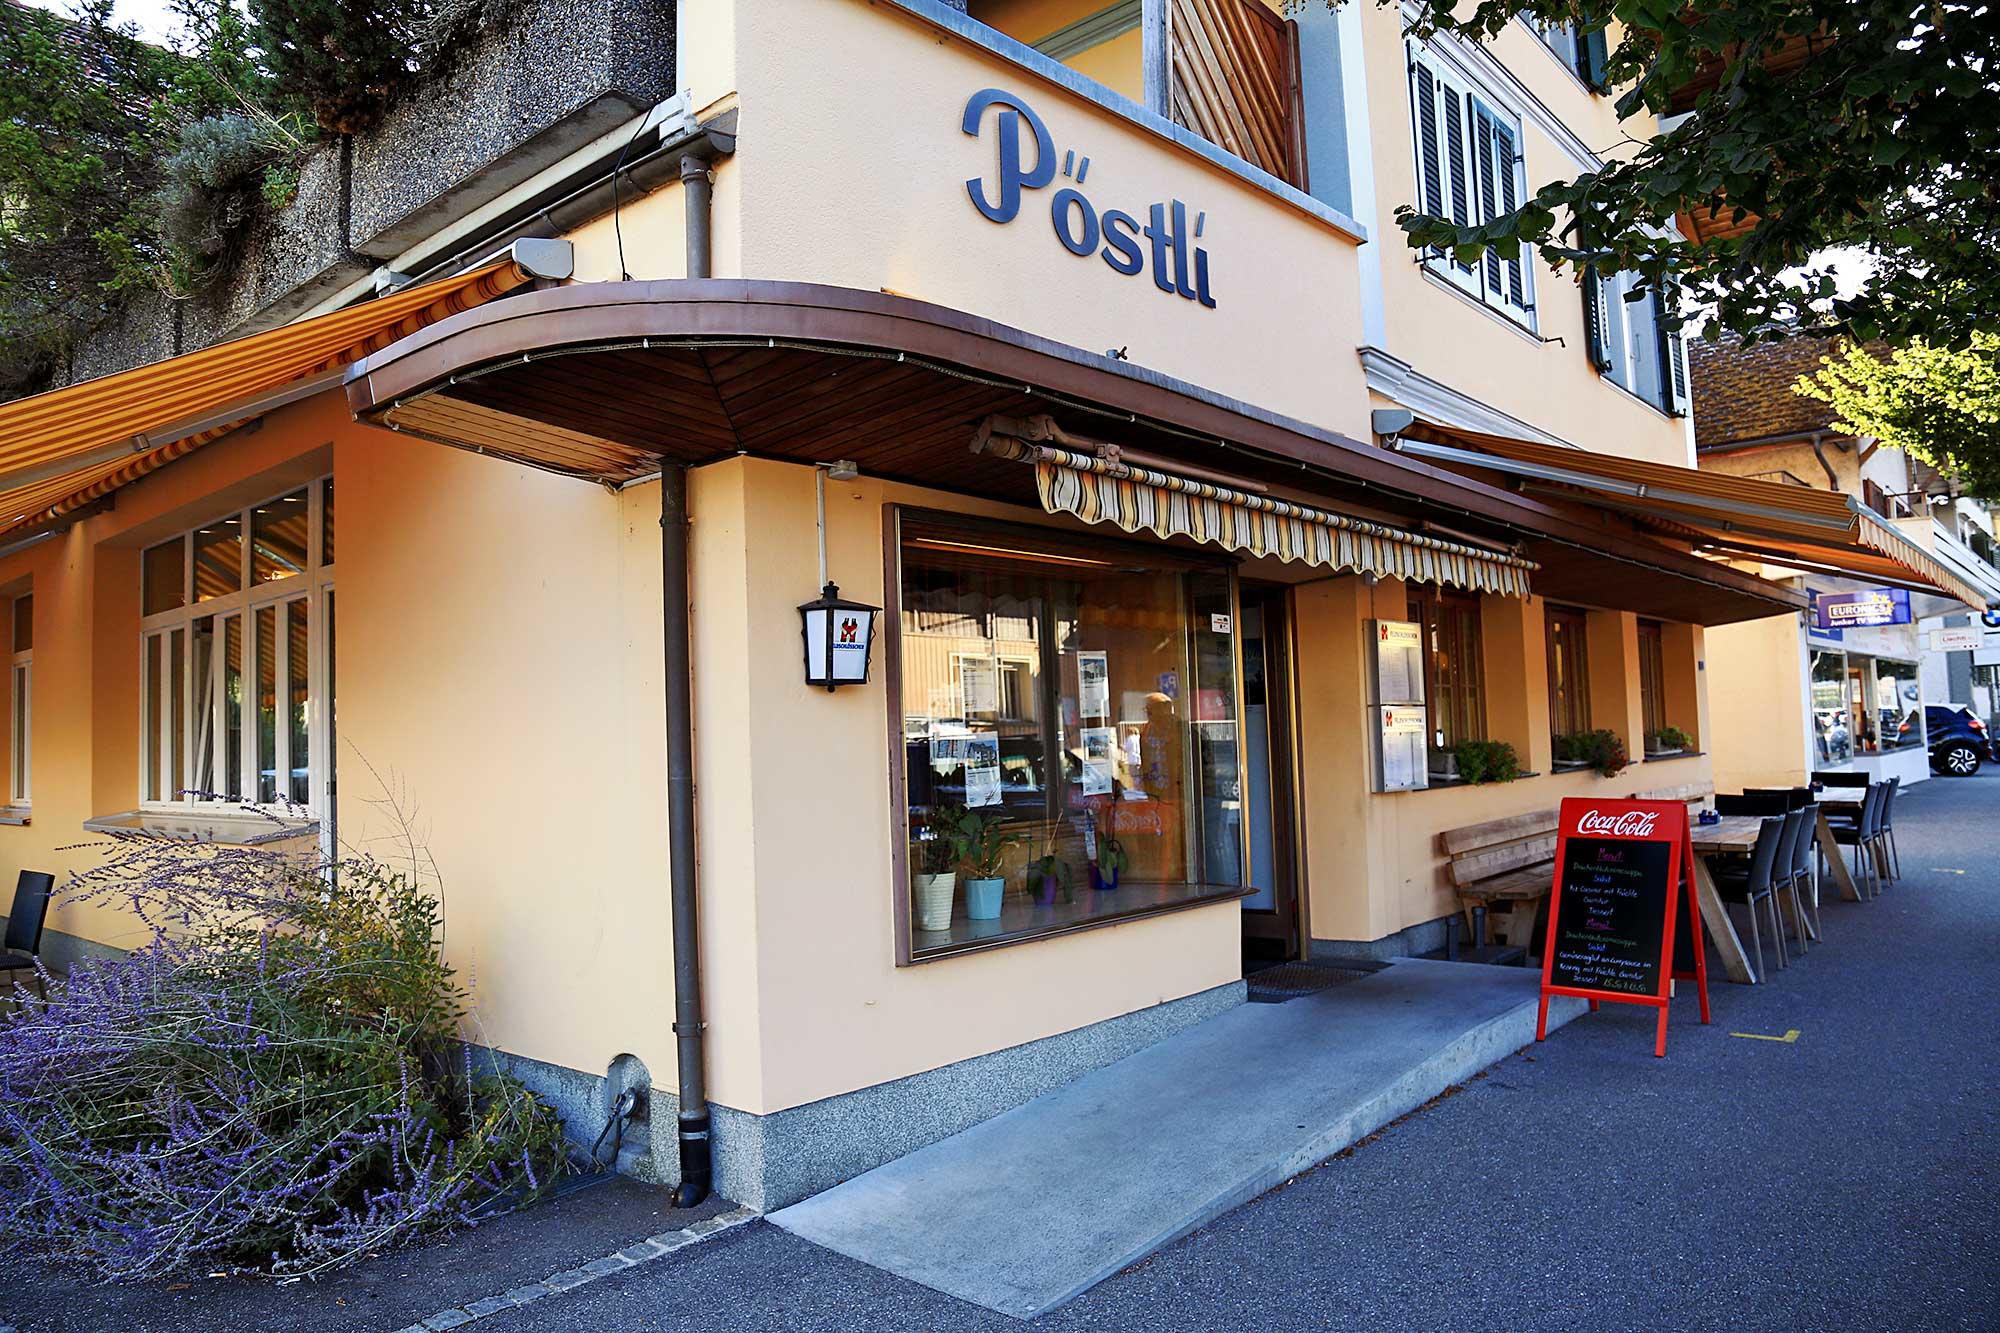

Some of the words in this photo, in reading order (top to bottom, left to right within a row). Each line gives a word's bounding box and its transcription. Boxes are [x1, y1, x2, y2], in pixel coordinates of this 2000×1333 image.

[962, 88, 1216, 309] Pöstli
[1832, 603, 1886, 616] EURONICS
[1830, 618, 1855, 627] Junker
[1856, 617, 1866, 625] TV
[1867, 616, 1890, 625] Video
[1577, 810, 1660, 837] Coca-Cola
